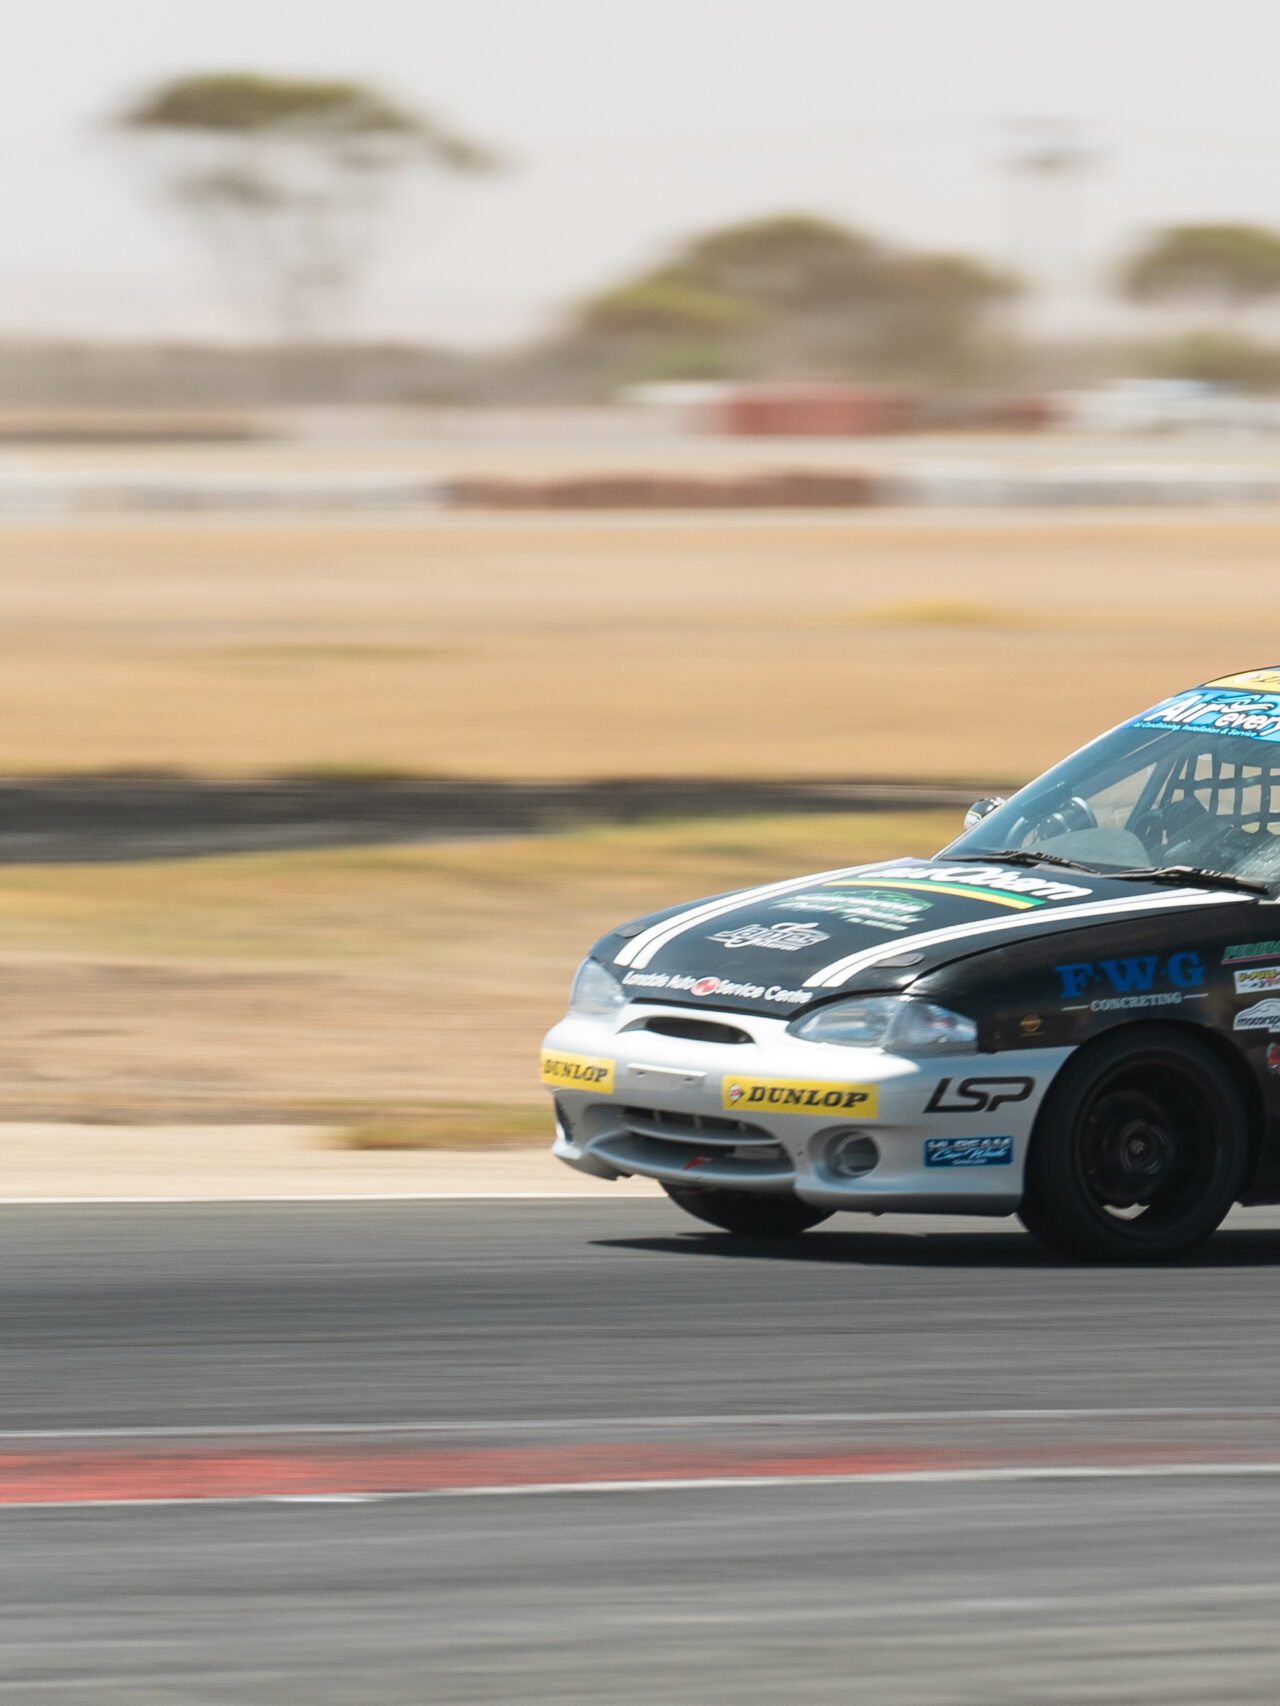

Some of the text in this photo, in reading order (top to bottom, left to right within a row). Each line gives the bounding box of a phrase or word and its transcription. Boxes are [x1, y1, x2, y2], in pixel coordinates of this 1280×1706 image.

[1143, 694, 1226, 723] Air
[1090, 992, 1183, 1012] CONCRETING
[542, 1059, 608, 1083] DUNLOP
[747, 1086, 869, 1109] DUNLOP
[922, 1076, 1036, 1114] LSP
